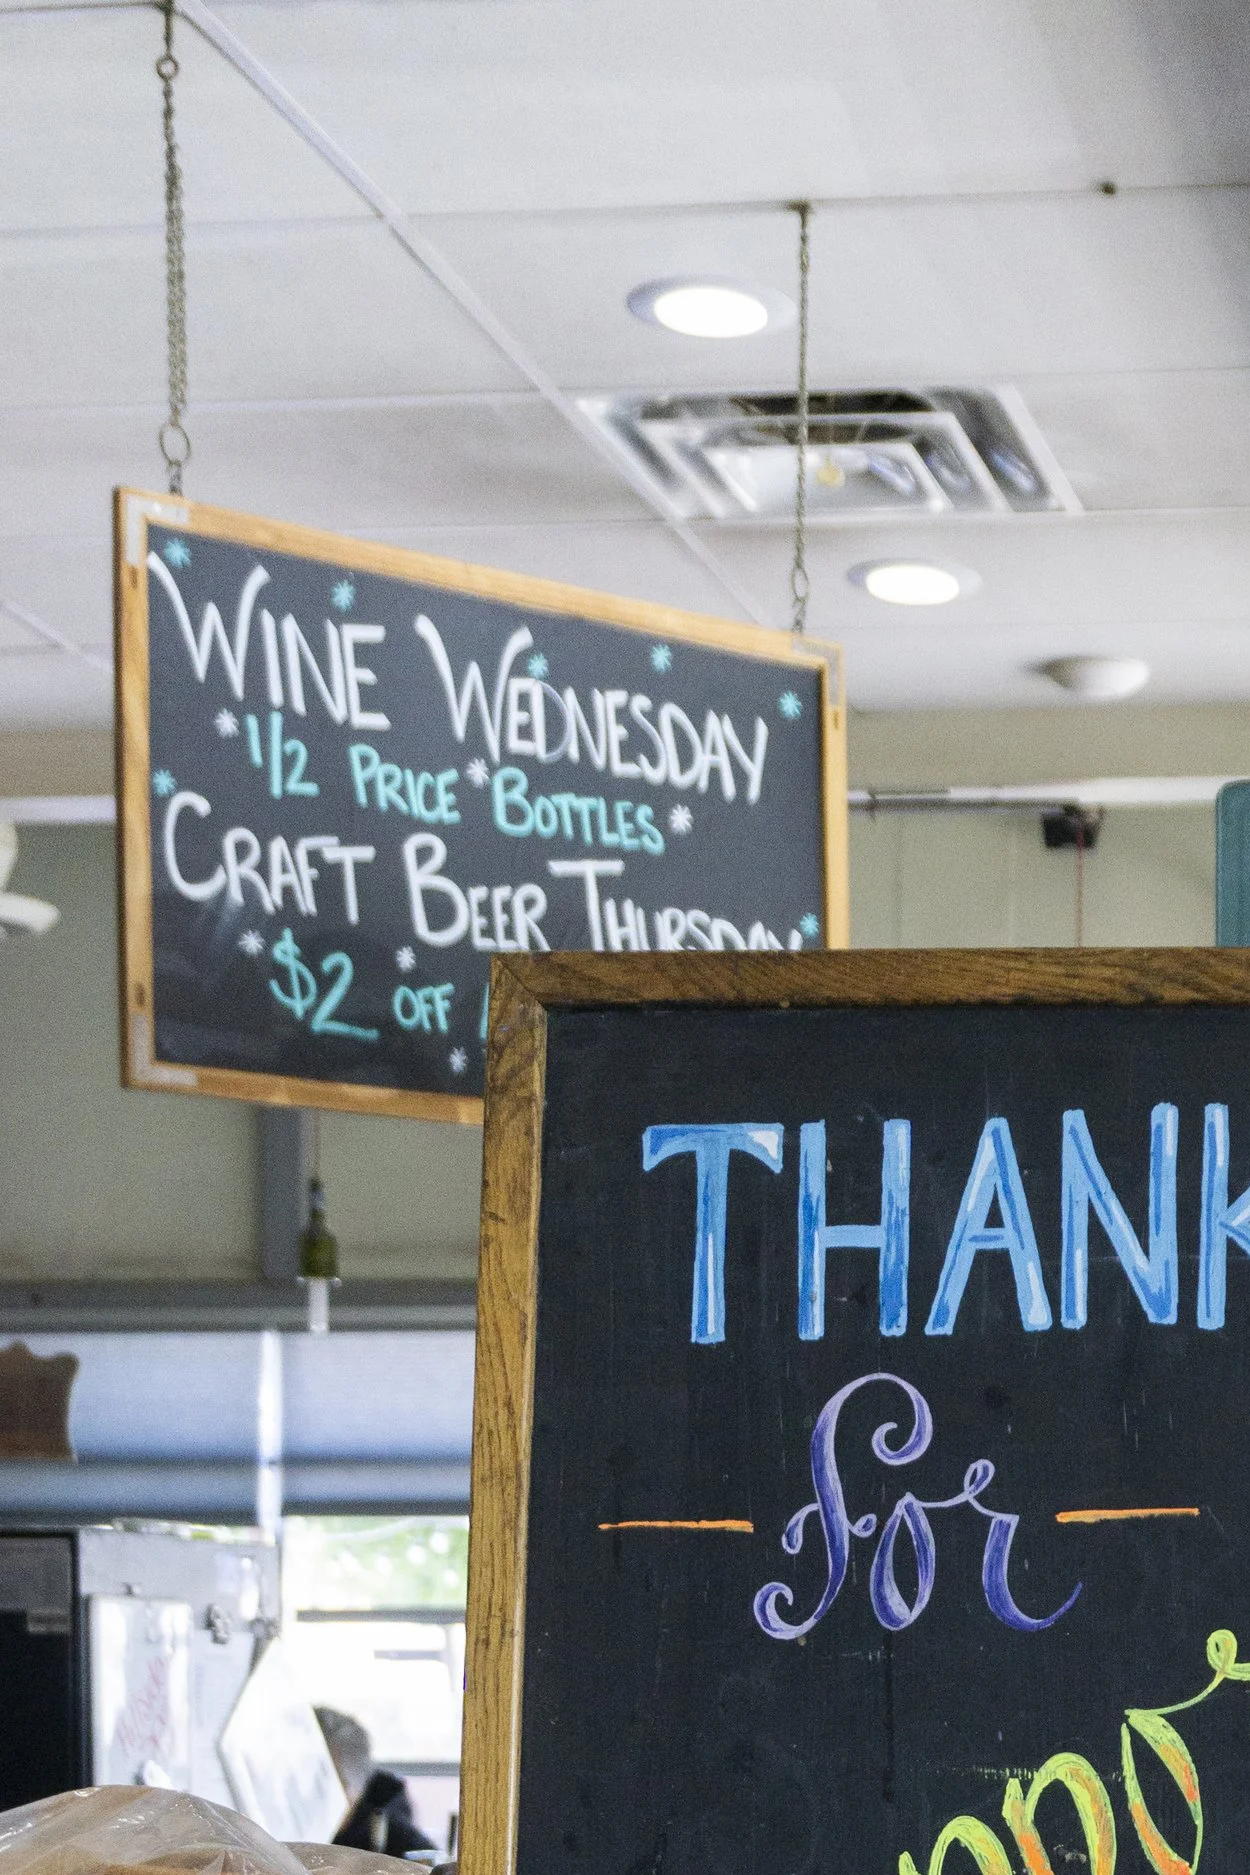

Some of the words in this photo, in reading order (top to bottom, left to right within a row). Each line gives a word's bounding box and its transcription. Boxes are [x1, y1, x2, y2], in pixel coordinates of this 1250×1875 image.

[147, 551, 391, 731] WINE
[415, 614, 770, 804] WEDNESDAY
[246, 712, 320, 799] 1/2
[349, 744, 461, 825] PRICE
[491, 766, 666, 855] BOTTLES
[164, 791, 376, 925] CRAFT
[403, 833, 552, 951] BEER
[268, 928, 378, 1040] $2
[392, 982, 456, 1032] OFF
[753, 1372, 1084, 1641] for
